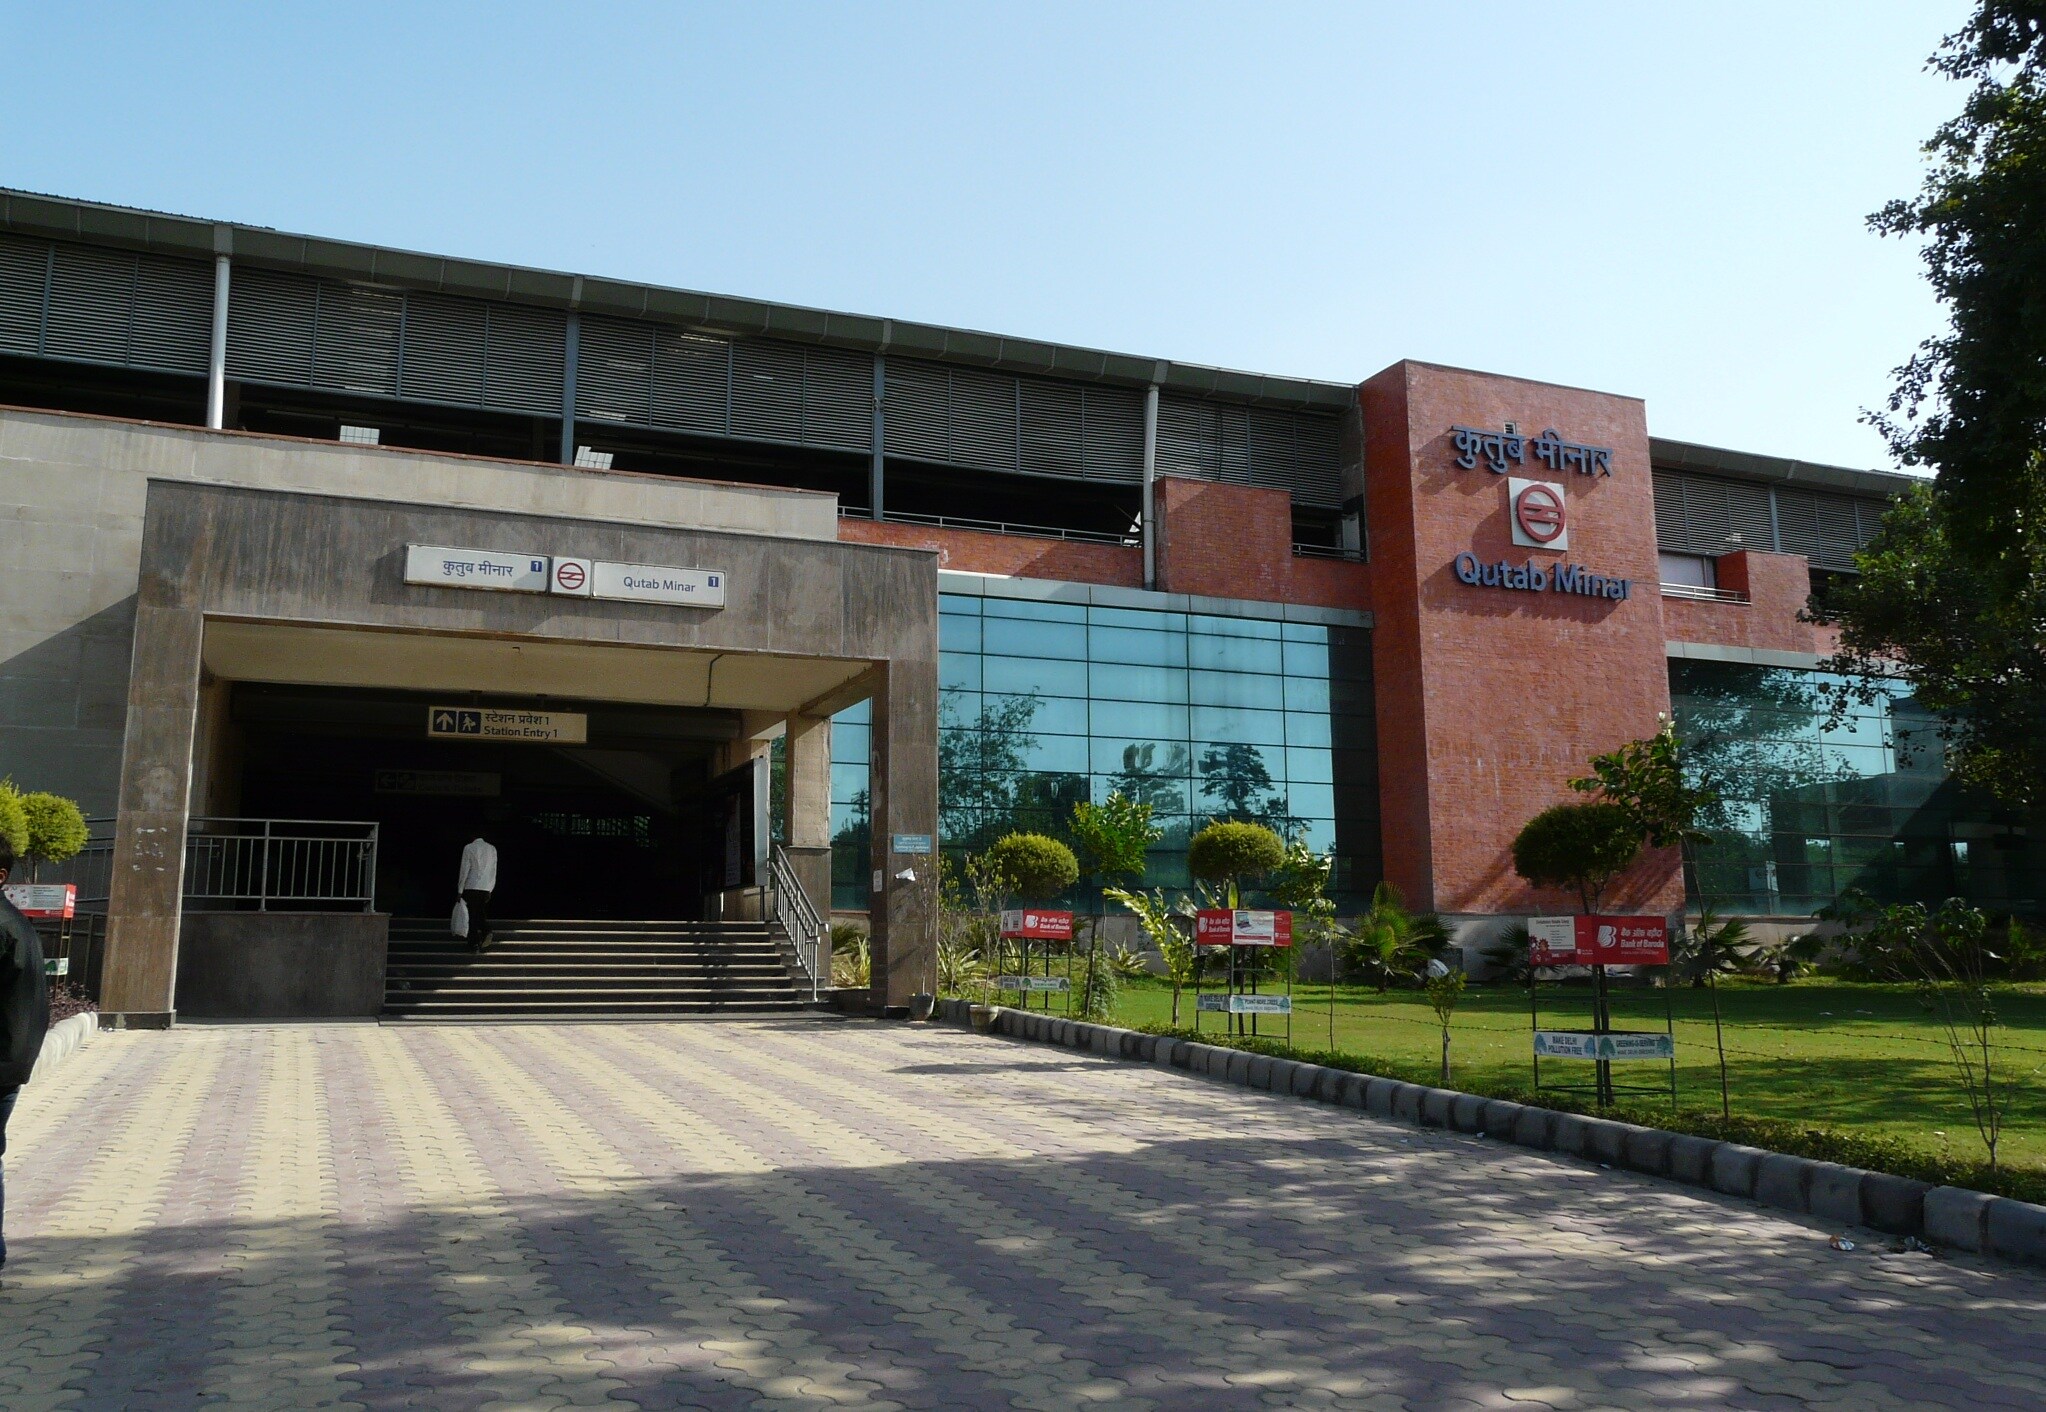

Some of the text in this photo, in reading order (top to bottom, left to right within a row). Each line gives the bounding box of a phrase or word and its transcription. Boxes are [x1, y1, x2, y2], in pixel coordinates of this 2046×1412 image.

[1451, 424, 1613, 477] कुतुब मीनार
[478, 560, 514, 577] मीनार
[1454, 551, 1633, 600] Qutab Minar
[623, 576, 696, 592] Qutab Minar
[485, 709, 515, 723] स्टेशन
[518, 712, 543, 725] प्रवेश
[484, 725, 558, 740] Station Entry 1
[1620, 939, 1665, 948] Bank of Baroda
[1552, 1036, 1577, 1045] MAKE DELHI
[1548, 1045, 1583, 1055] POLLUTION FREE
